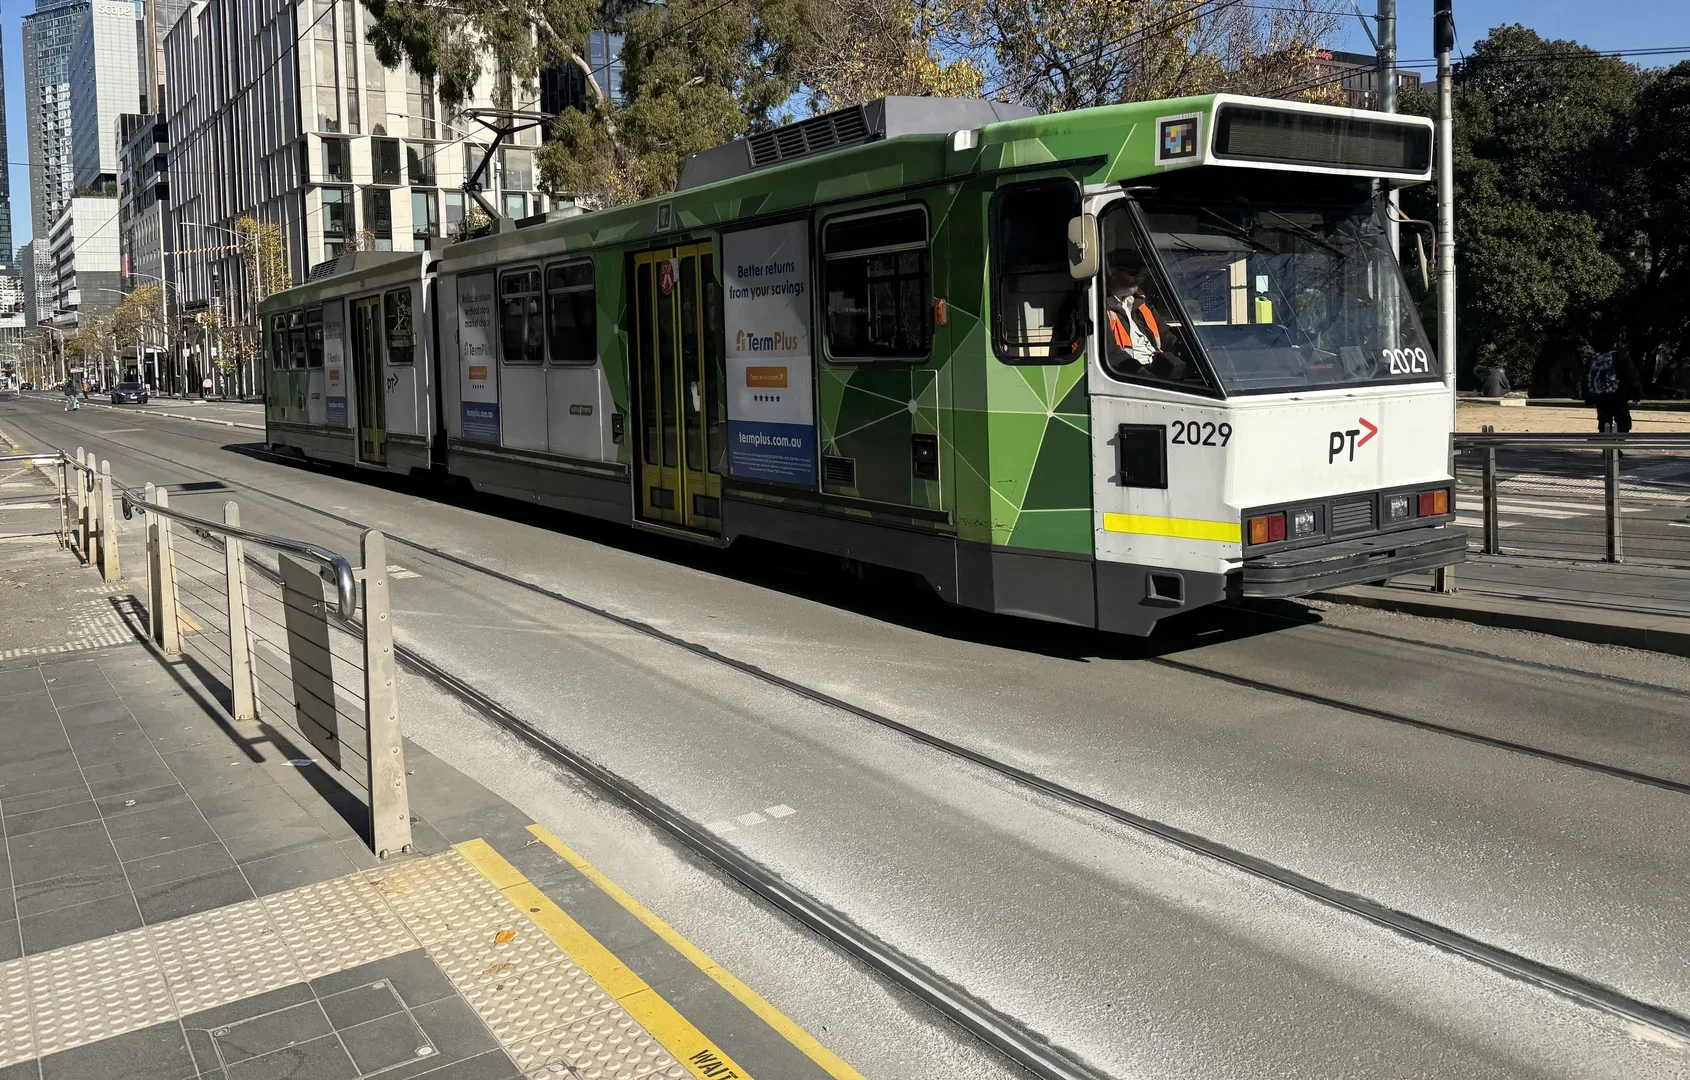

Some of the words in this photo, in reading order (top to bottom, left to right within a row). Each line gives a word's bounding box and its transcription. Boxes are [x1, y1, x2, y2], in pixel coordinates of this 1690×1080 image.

[98, 4, 131, 20] scape
[737, 263, 763, 279] Better
[765, 261, 795, 275] returns
[729, 285, 749, 299] from
[750, 284, 770, 301] your
[771, 279, 804, 297] savings
[746, 330, 798, 352] TermPlus
[1382, 347, 1429, 375] 2029
[738, 431, 803, 449] termplus.com.au
[1171, 420, 1233, 447] 2029
[688, 1049, 740, 1080] WAIT
